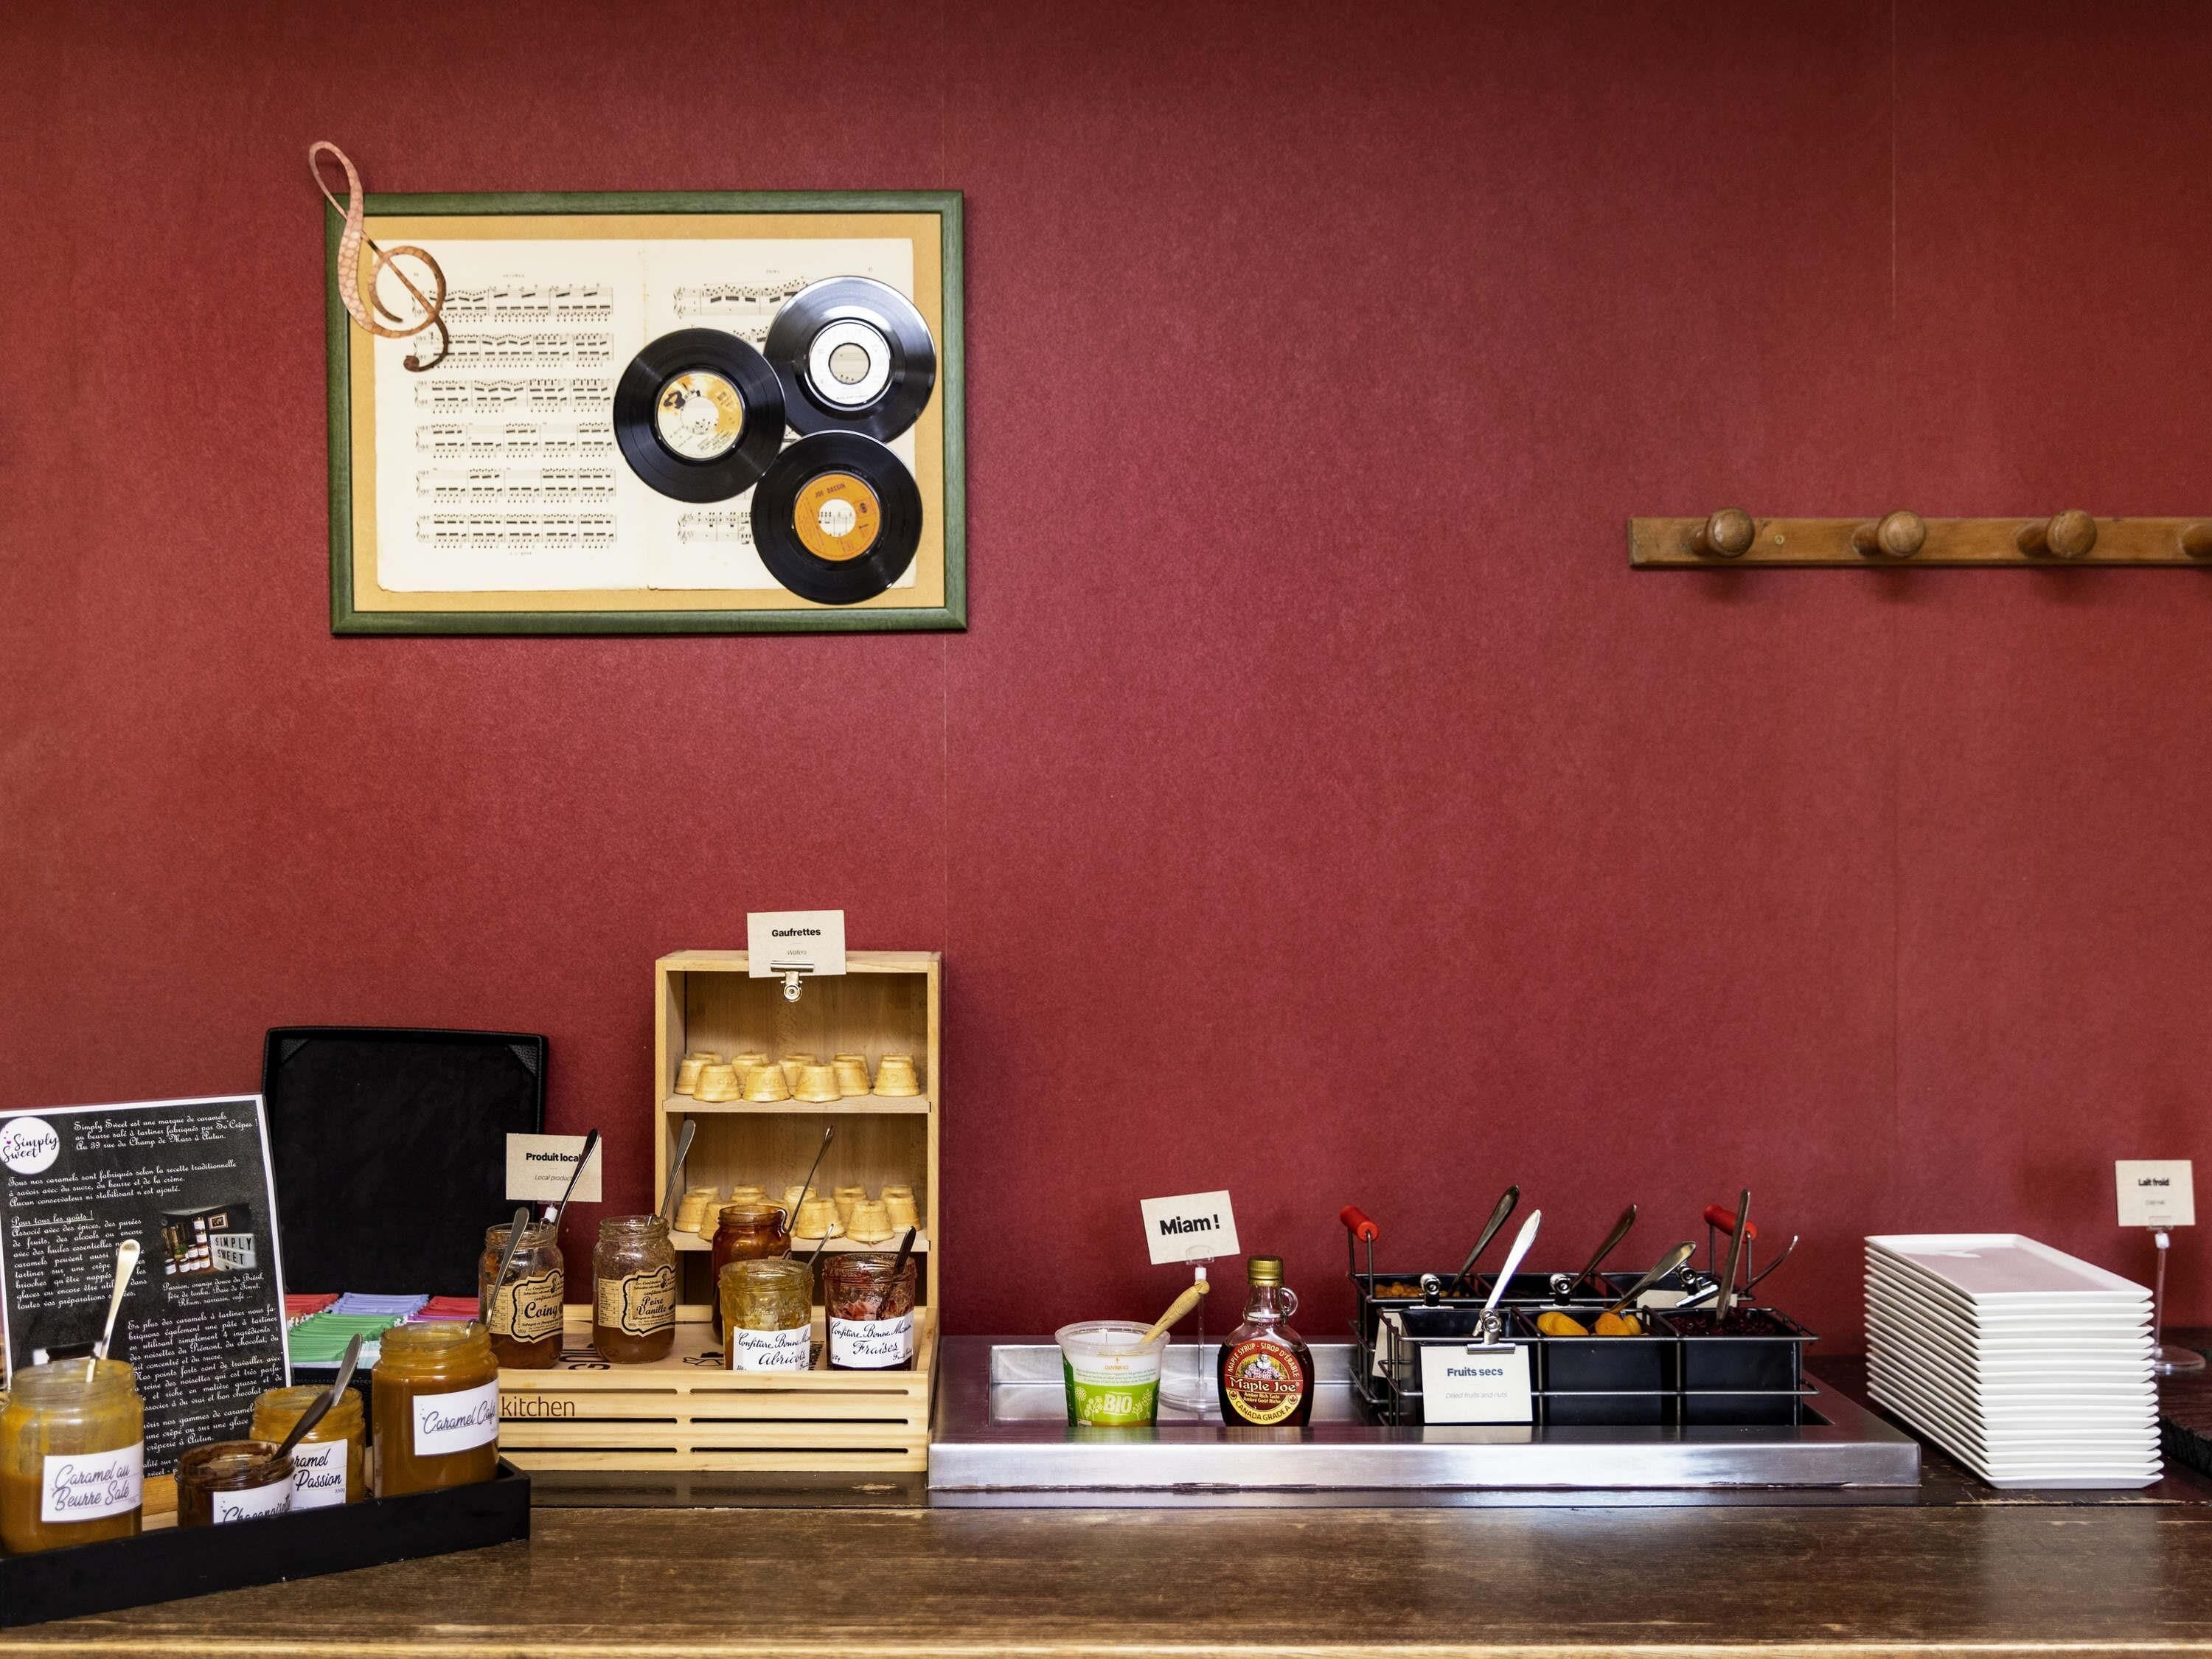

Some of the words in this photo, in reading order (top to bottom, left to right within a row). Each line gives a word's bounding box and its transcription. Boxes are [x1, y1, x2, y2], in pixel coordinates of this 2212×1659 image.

[772, 928, 821, 936] Gaufrettes
[74, 1121, 102, 1133] Simply
[105, 1119, 128, 1129] Sweet
[159, 1119, 184, 1127] marque
[198, 1112, 227, 1121] caramels
[87, 1132, 109, 1140] beurre
[112, 1130, 127, 1138] salé
[137, 1127, 164, 1135] tartiner
[167, 1125, 198, 1137] fabriqués
[201, 1126, 213, 1134] par
[129, 1136, 155, 1148] Champ
[170, 1134, 192, 1143] Mars
[13, 1133, 58, 1153] Simply
[2, 1145, 38, 1163] Sweet
[526, 1152, 559, 1161] Produit
[560, 1153, 581, 1161] local
[8, 1177, 28, 1186] Tous
[46, 1173, 80, 1183] caramels
[100, 1170, 133, 1182] fabriqués
[136, 1167, 153, 1176] selon
[156, 1166, 164, 1174] la
[192, 1159, 237, 1171] traditionnelle
[108, 1179, 131, 1187] beurre
[2152, 1178, 2169, 1186] froid
[10, 1197, 35, 1207] Aucun
[38, 1195, 83, 1205] conservateur
[96, 1189, 134, 1199] stabilisant
[156, 1186, 181, 1197] ajouté.
[12, 1217, 31, 1227] Pour
[53, 1214, 63, 1222] les
[66, 1213, 87, 1224] goûts
[12, 1227, 41, 1237] Associé
[77, 1223, 101, 1232] épices,
[119, 1219, 142, 1229] purées
[1159, 1216, 1211, 1235] Miam
[1214, 1214, 1220, 1229] !
[27, 1238, 50, 1249] fruits,
[74, 1231, 100, 1241] alcools
[215, 1237, 252, 1250] SIMPLY
[218, 1249, 244, 1265] SWEET
[128, 1320, 139, 1330] En
[143, 1318, 159, 1332] plus
[161, 1318, 173, 1326] des
[176, 1312, 207, 1324] caramels
[266, 1304, 276, 1316] fa-
[524, 1301, 558, 1318] Coing
[128, 1331, 160, 1342] briquons
[164, 1325, 201, 1338] également
[222, 1319, 237, 1331] pâte
[251, 1316, 278, 1325] tartiner
[143, 1338, 173, 1349] utilisant
[178, 1330, 218, 1345] simplement
[233, 1326, 271, 1338] ingrédients
[831, 1321, 863, 1339] Confiture
[863, 1324, 891, 1338] Bonne
[738, 1332, 773, 1350] Confiture
[775, 1333, 799, 1349] Bonne
[852, 1340, 897, 1354] Fraises
[759, 1351, 805, 1365] Abricots
[1228, 1353, 1239, 1373] MAPLE
[1237, 1343, 1255, 1355] SYRUP
[1260, 1343, 1279, 1352] SIROP
[1279, 1350, 1300, 1377] D'ÉRABLE
[1447, 1366, 1477, 1377] Fruits
[1229, 1377, 1270, 1393] Maple
[501, 1396, 575, 1416] kitchen
[1103, 1394, 1133, 1414] BIO
[1236, 1401, 1262, 1420] CANADA
[423, 1406, 476, 1434] Caramel
[293, 1447, 330, 1467] ramel
[55, 1460, 117, 1491] Caramel
[116, 1466, 130, 1478] au
[293, 1469, 341, 1491] Passion
[52, 1486, 102, 1512] Beurre
